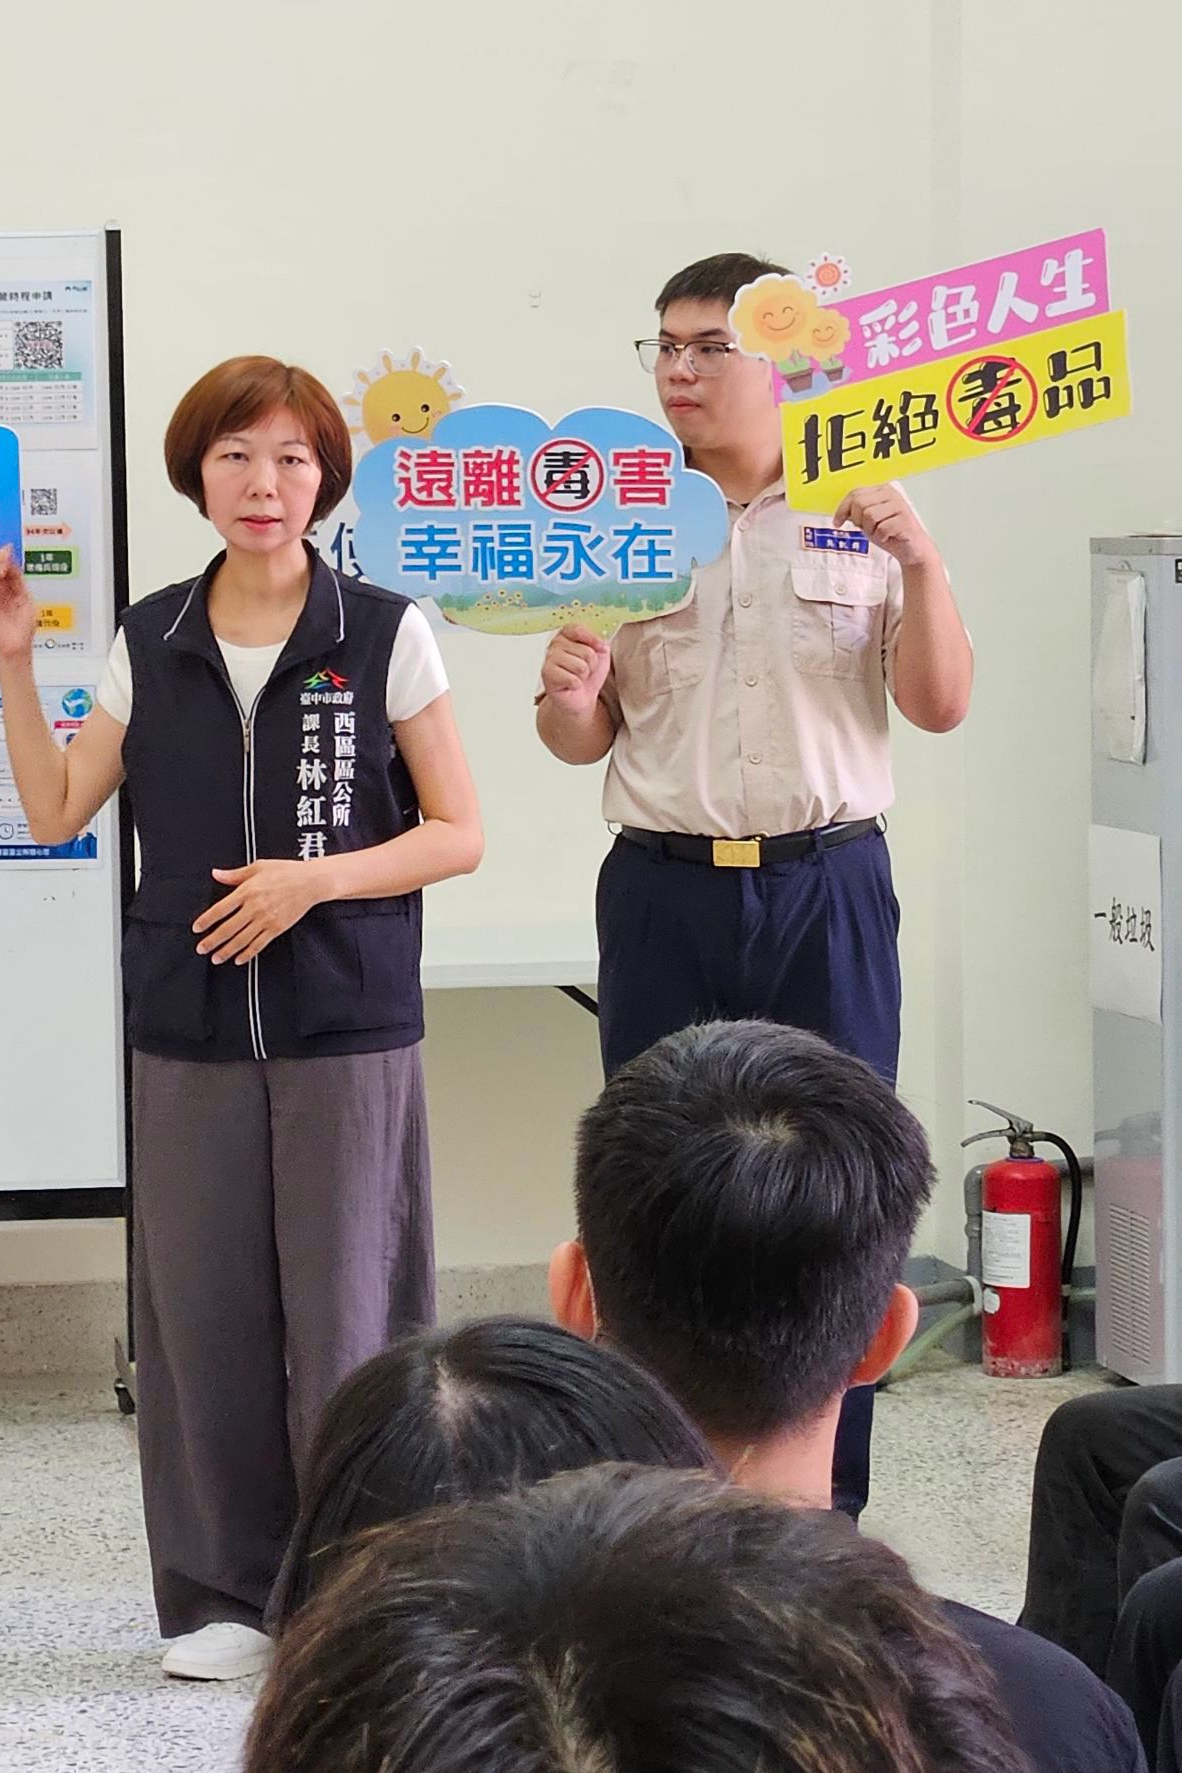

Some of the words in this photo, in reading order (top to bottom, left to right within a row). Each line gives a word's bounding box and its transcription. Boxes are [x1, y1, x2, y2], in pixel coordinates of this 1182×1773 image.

[859, 248, 1097, 369] 彩色人生
[799, 340, 1111, 485] 拒絕毒品
[395, 446, 673, 510] 遠離毒害
[401, 521, 674, 581] 幸福永在
[299, 691, 354, 706] 臺中市政府
[301, 713, 321, 754] 課長
[332, 711, 357, 827] 西區區公所
[296, 758, 328, 861] 林紅君
[1094, 896, 1155, 952] 一般垃圾
